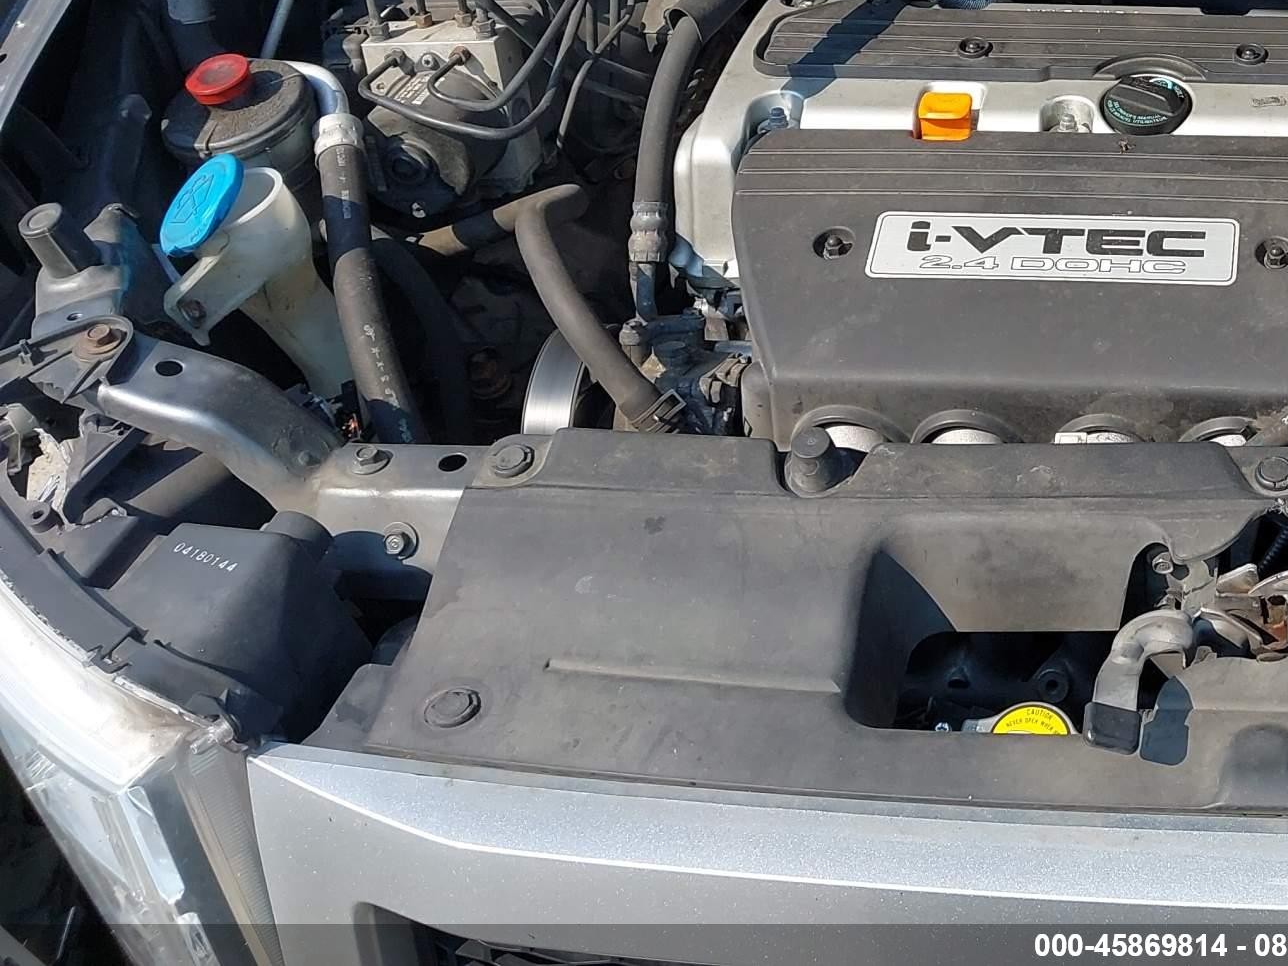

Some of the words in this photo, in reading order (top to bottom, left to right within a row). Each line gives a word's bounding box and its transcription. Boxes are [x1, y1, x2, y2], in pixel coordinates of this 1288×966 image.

[906, 220, 1206, 258] i-VTEC
[919, 254, 1000, 271] 2.4
[1011, 256, 1187, 275] DOHC
[173, 542, 238, 572] 04180144
[1026, 708, 1053, 721] CAUTION
